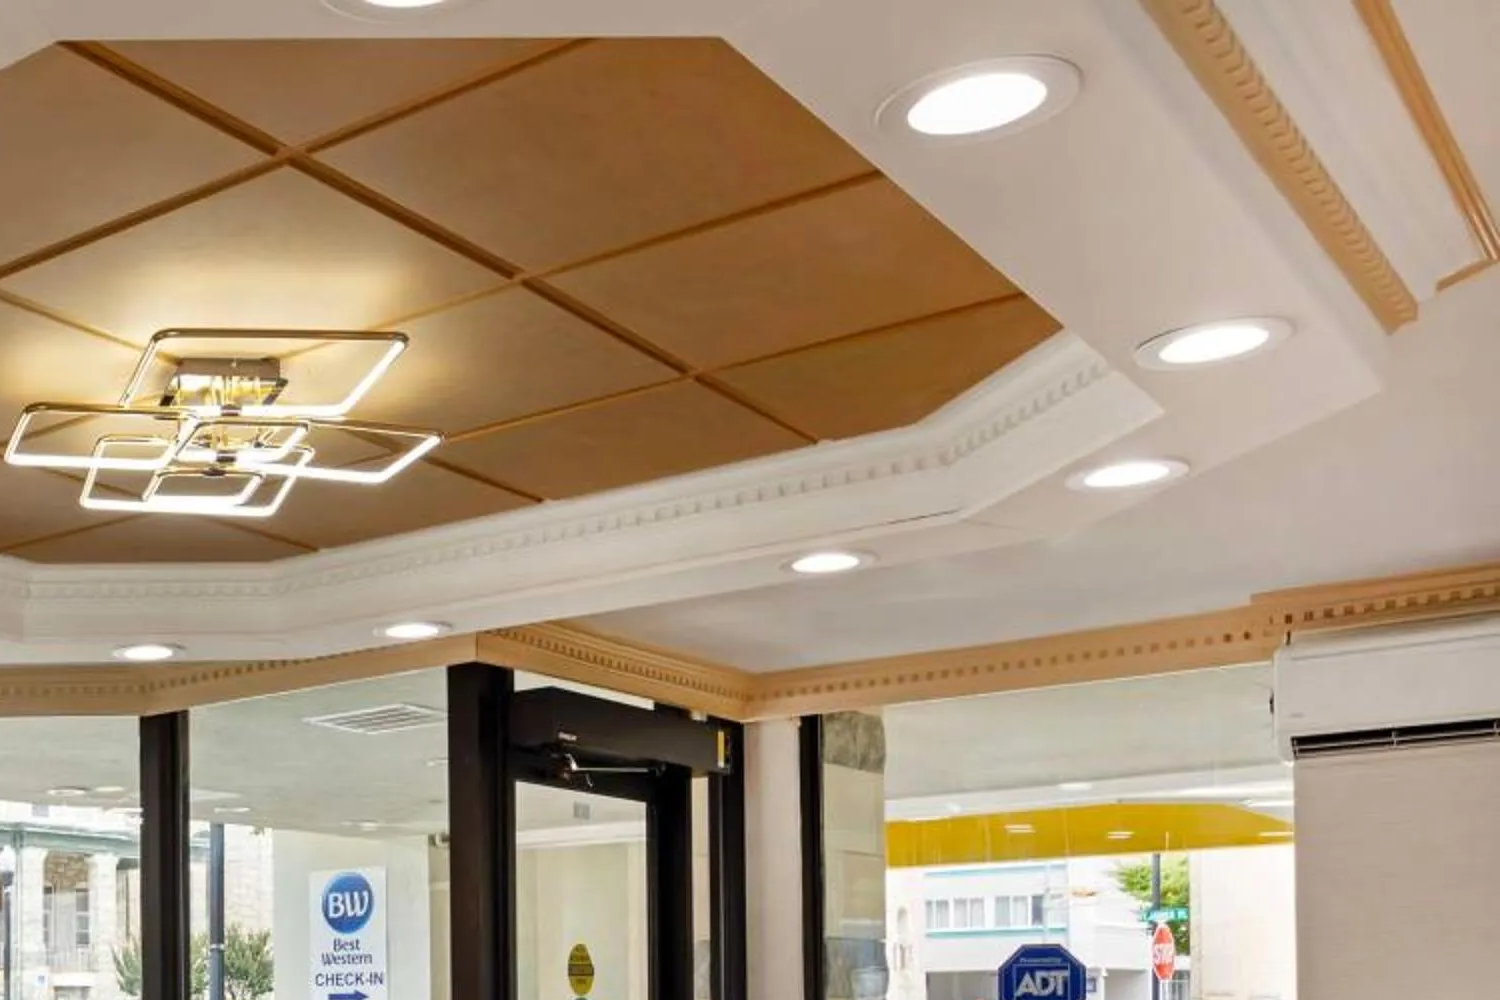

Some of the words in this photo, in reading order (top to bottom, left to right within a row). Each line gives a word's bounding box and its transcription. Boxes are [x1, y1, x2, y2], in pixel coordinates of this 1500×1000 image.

[329, 891, 369, 918] BW
[333, 939, 361, 951] Best
[322, 953, 373, 966] Western
[315, 973, 384, 987] CHECK-IN
[1015, 971, 1070, 997] ADT
